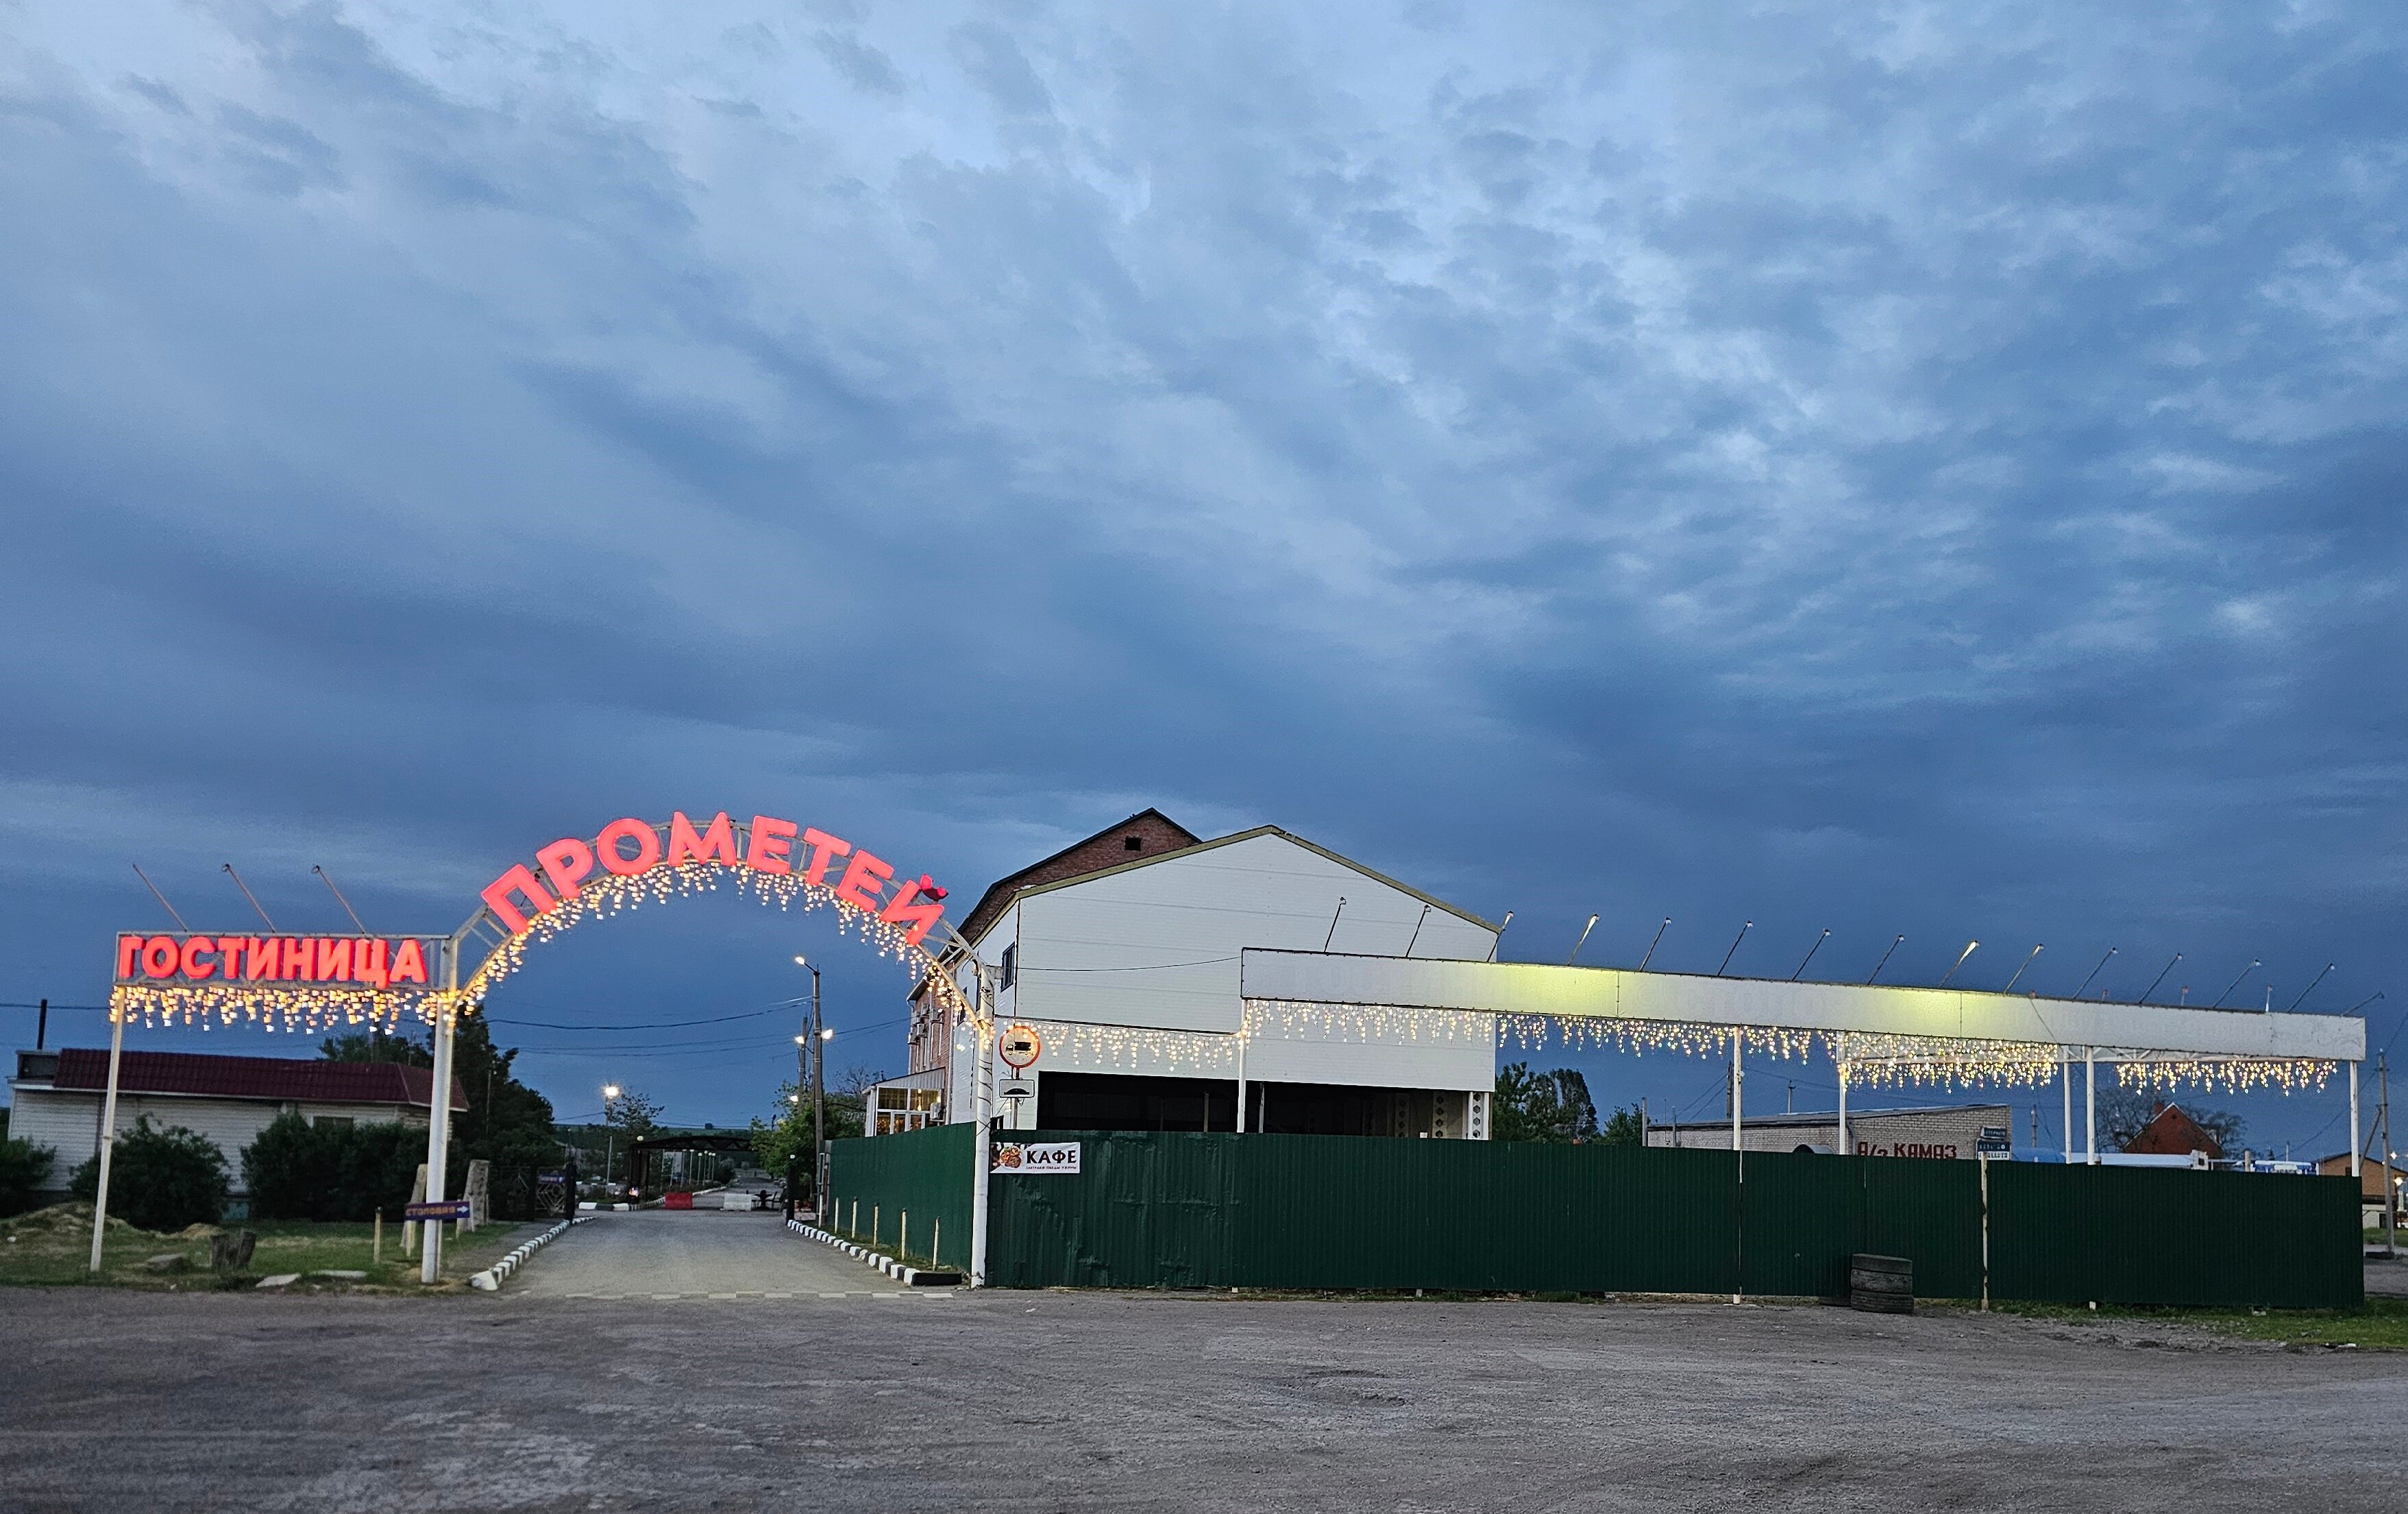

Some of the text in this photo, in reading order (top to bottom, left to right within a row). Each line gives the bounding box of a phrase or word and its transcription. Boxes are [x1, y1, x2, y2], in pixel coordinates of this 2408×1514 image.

[482, 811, 948, 947] ПРОМЕТЕЙ
[119, 936, 428, 988] ГОСТИНИЦА
[1027, 1150, 1077, 1164] КАФЕ
[1894, 1143, 1956, 1158] КАМАЗ
